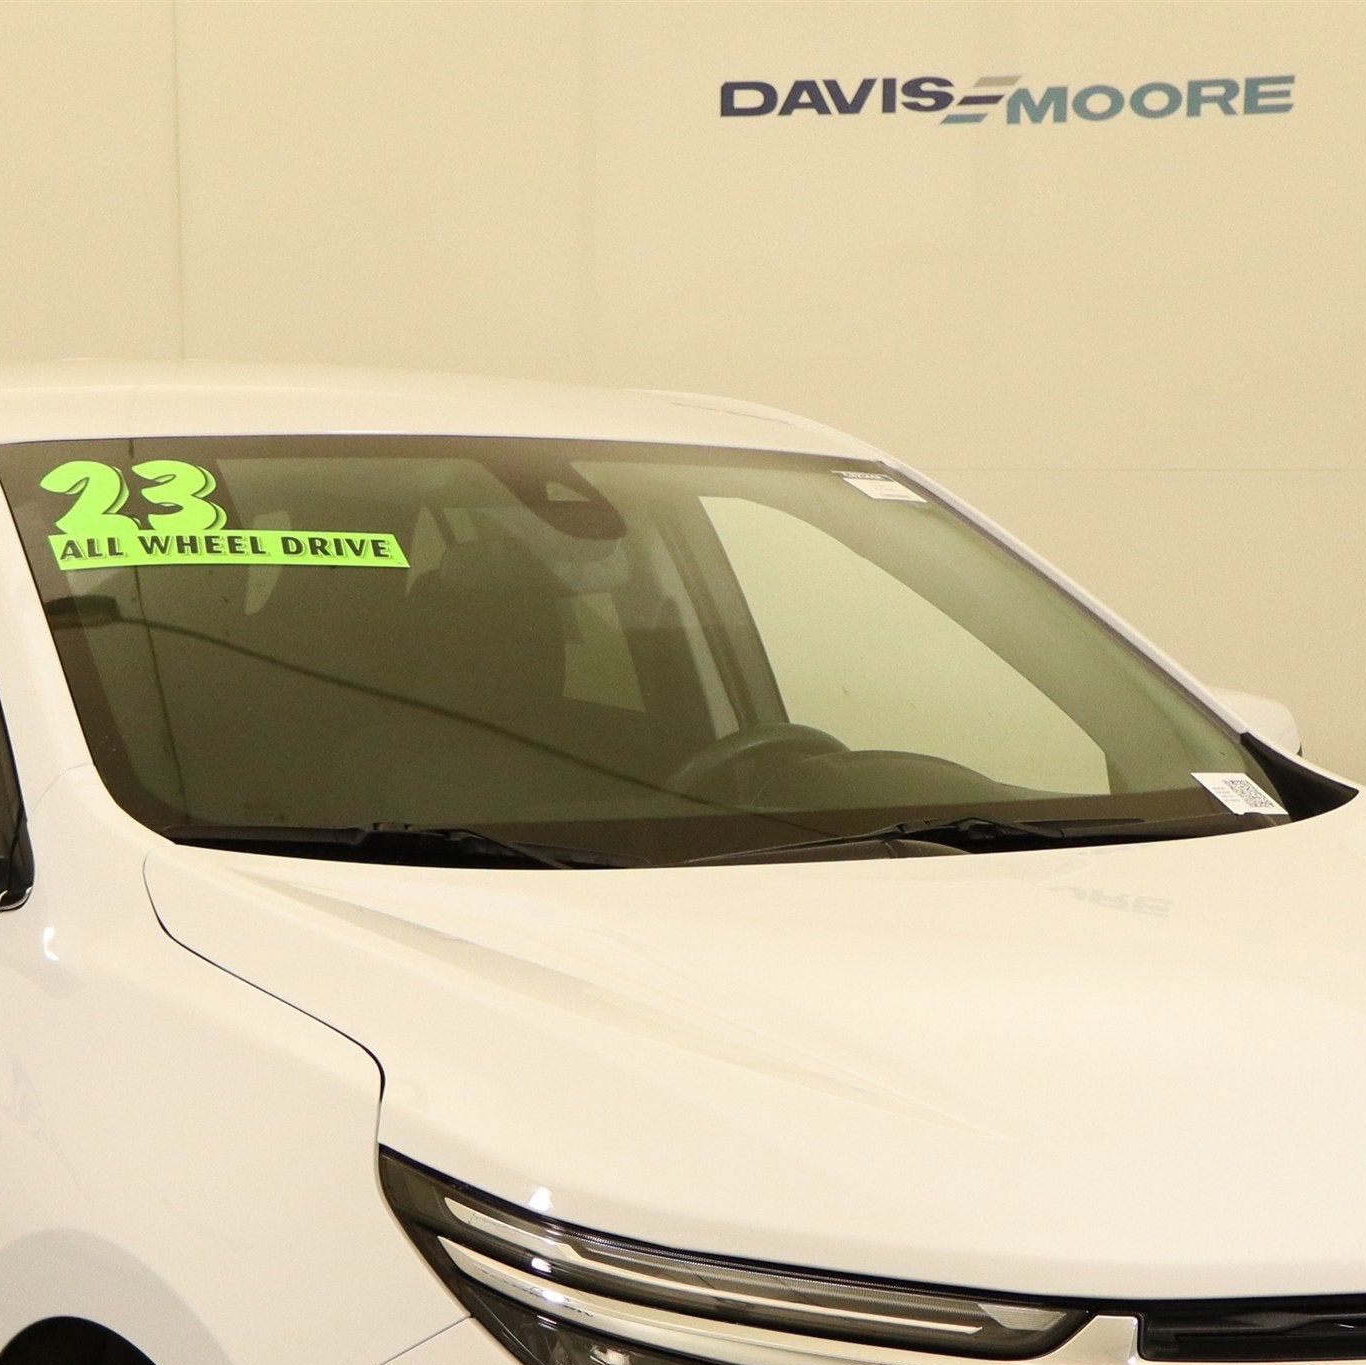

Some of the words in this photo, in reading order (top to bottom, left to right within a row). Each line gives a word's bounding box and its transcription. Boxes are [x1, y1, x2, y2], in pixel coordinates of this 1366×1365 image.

[720, 75, 955, 117] DAVIS
[1006, 74, 1296, 124] MOORE
[40, 460, 228, 531] 23
[59, 536, 126, 561] ALL
[138, 536, 267, 557] WHEEL
[281, 536, 392, 559] DRIVE
